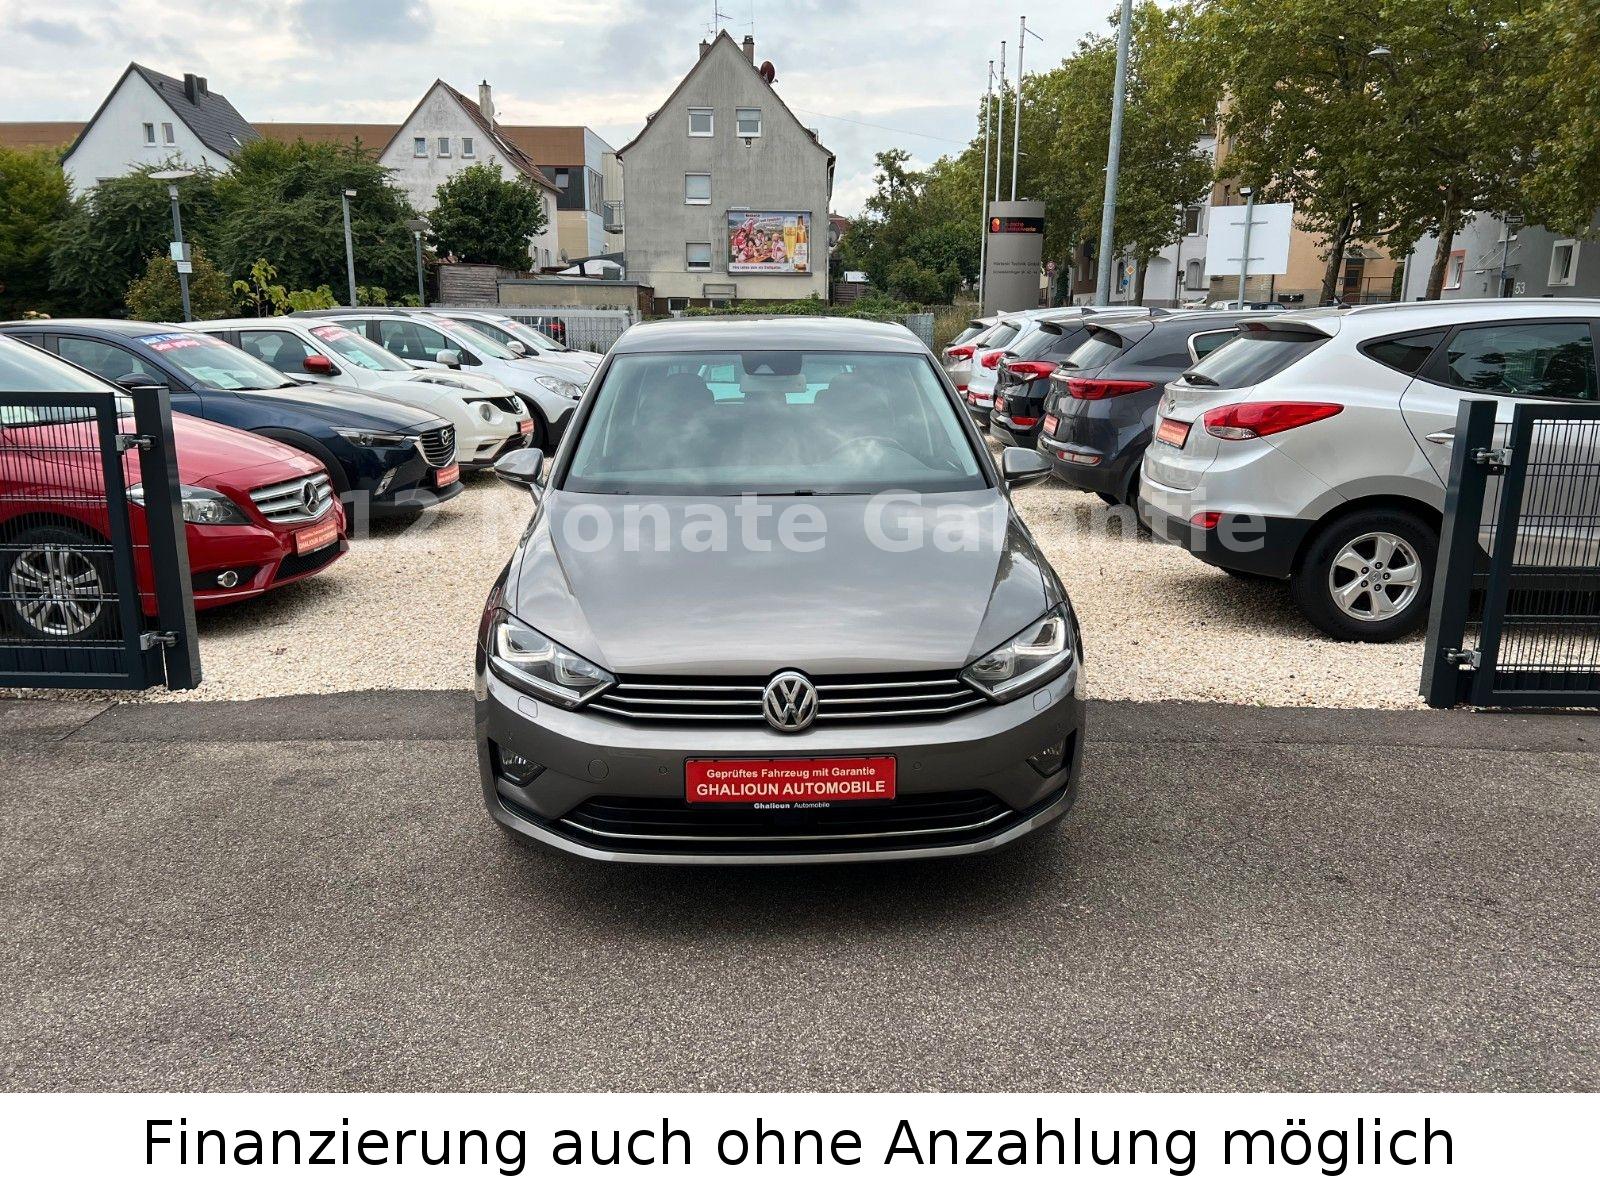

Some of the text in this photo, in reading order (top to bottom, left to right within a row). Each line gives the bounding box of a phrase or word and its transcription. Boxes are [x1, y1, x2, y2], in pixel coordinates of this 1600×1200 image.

[1514, 281, 1526, 295] 53
[762, 671, 819, 732] VW
[706, 766, 876, 780] Geprüftes Fahrzeug mit Garantie
[696, 780, 886, 796] GHALIOUN AUTOMOBILE
[793, 801, 830, 809] Automobile
